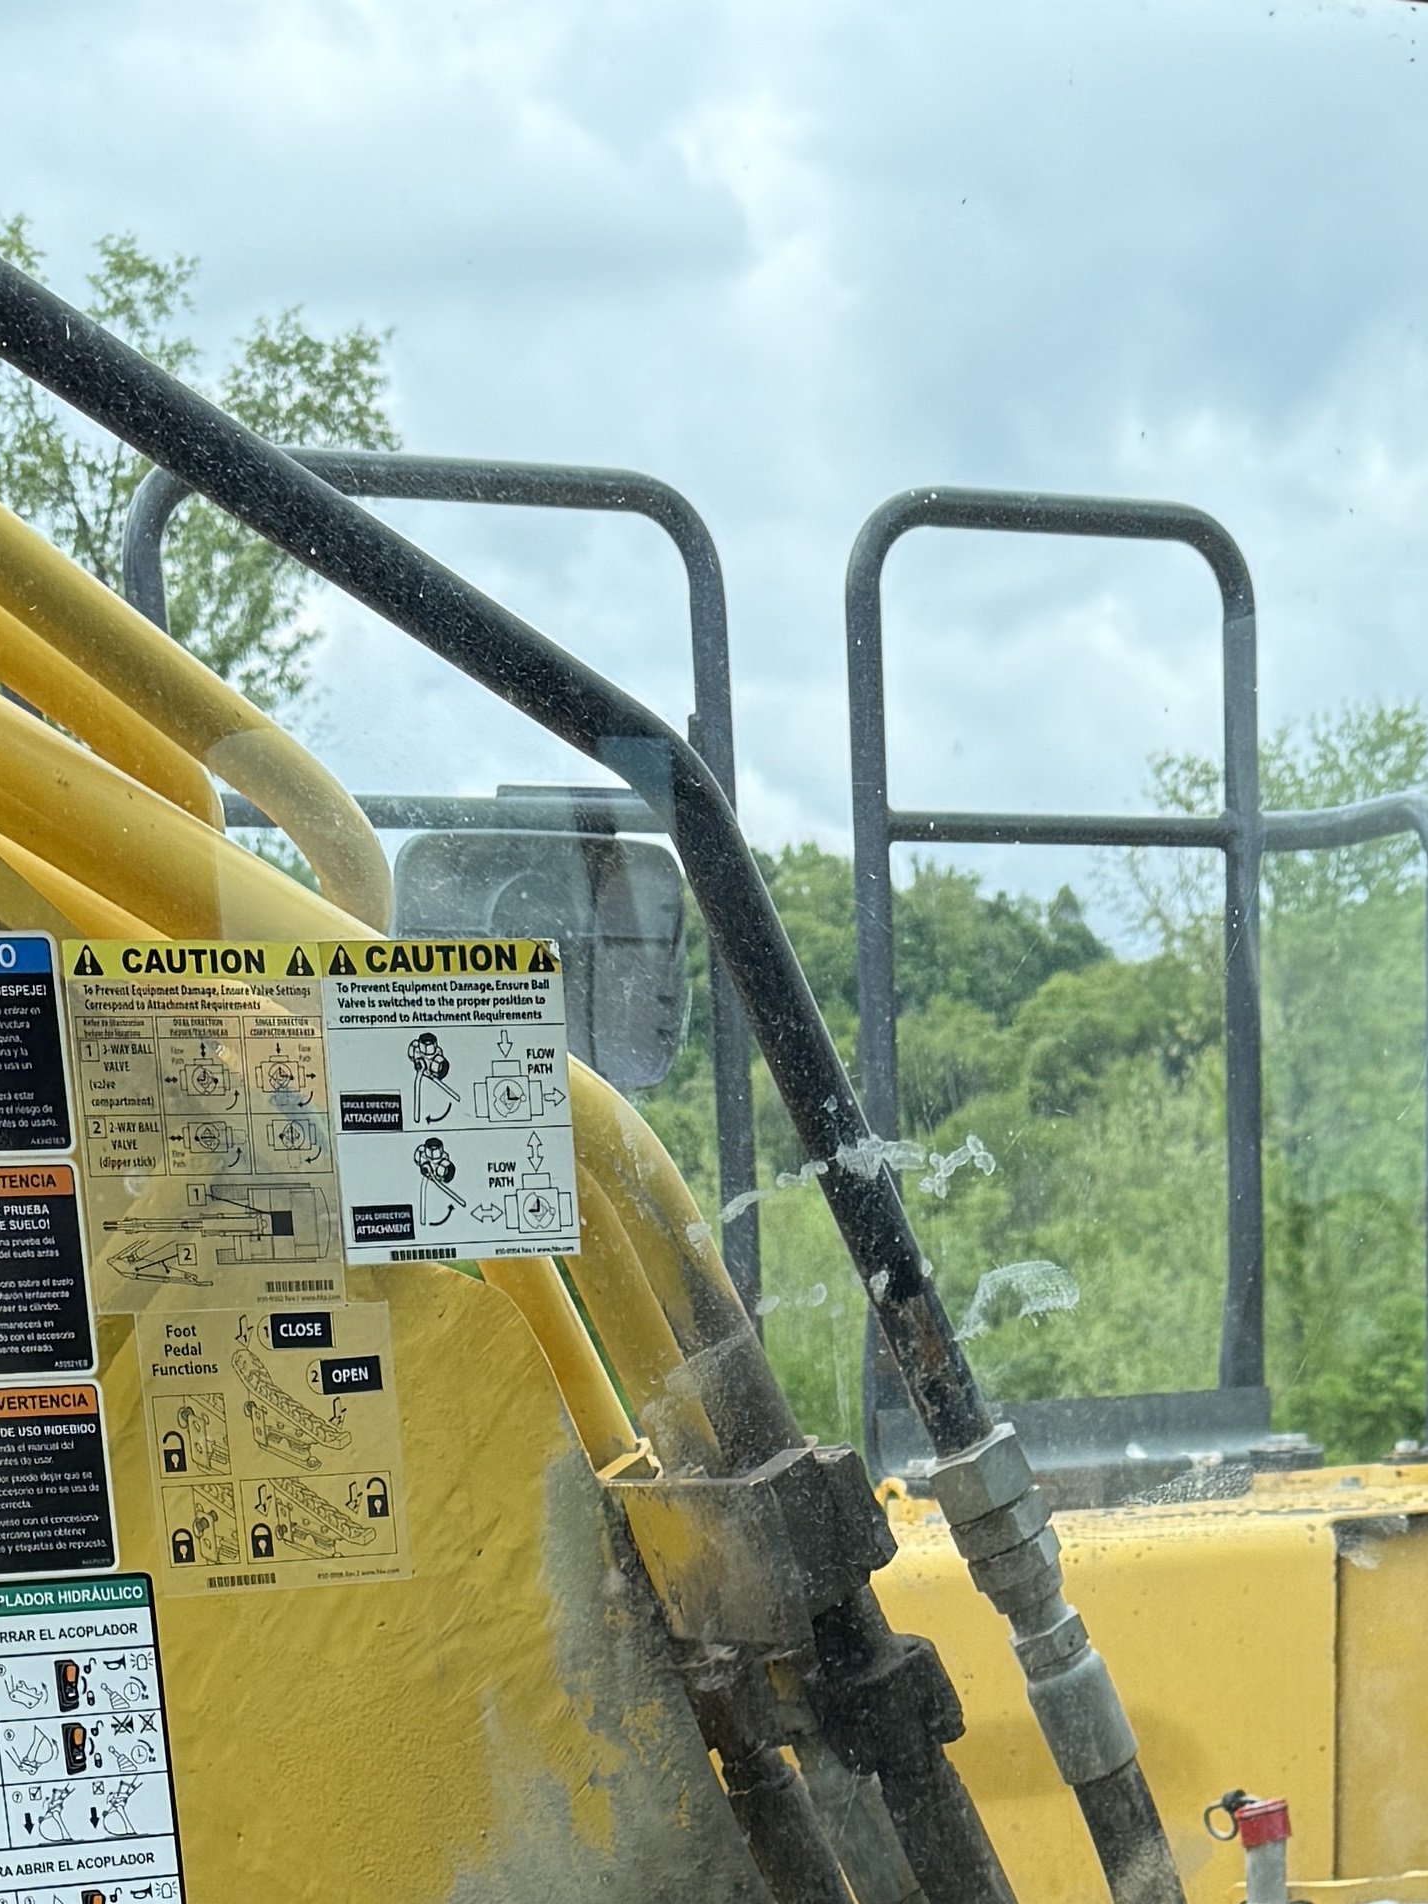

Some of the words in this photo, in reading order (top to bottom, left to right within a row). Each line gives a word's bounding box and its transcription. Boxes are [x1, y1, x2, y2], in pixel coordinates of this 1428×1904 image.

[122, 948, 265, 974] CAUTION
[365, 944, 517, 972] CAUTION
[83, 985, 93, 995] To
[96, 985, 129, 996] Prevent
[132, 985, 179, 997] Equipment
[181, 985, 219, 998] Damage,
[221, 986, 249, 995] Ensure
[251, 986, 274, 995] Valve
[276, 985, 311, 997] Settings
[336, 983, 348, 993] To
[350, 982, 389, 993] Prevent
[392, 982, 448, 995] Equipment
[450, 980, 493, 994] Damage,
[495, 980, 528, 989] Ensure
[531, 979, 549, 989] Ball
[85, 1001, 134, 1013] Correspond
[137, 1001, 146, 1010] to
[147, 1000, 198, 1010] Attachment
[201, 1000, 261, 1011] Requirements
[338, 998, 365, 1008] Valve
[367, 998, 375, 1008] is
[378, 997, 422, 1008] switched
[425, 996, 435, 1005] to
[438, 996, 454, 1006] the
[457, 997, 490, 1008] proper
[493, 995, 533, 1006] position
[535, 995, 545, 1004] to
[339, 1013, 397, 1025] correspond
[399, 1012, 409, 1022] to
[412, 1011, 471, 1022] Attachment
[473, 1010, 542, 1022] Requirements
[87, 1045, 92, 1057] 1
[103, 1044, 129, 1055] 3-WAY
[131, 1044, 153, 1054] BALL
[526, 1048, 554, 1060] FLOW
[104, 1062, 130, 1072] VALVE
[527, 1064, 552, 1074] PATH
[90, 1080, 115, 1091] (valve
[91, 1097, 154, 1108] compartment)
[344, 1113, 399, 1123] ATTACHMENT
[93, 1122, 101, 1133] 2
[110, 1122, 136, 1133] 2-WAY
[139, 1122, 159, 1132] BALL
[112, 1140, 138, 1150] VALVE
[100, 1157, 131, 1169] (dipper
[134, 1155, 156, 1168] stick)
[488, 1162, 516, 1173] FLOW
[489, 1177, 514, 1188] PATH
[4, 1204, 49, 1216] PRUEBA
[10, 1219, 50, 1230] SUELO!
[356, 1223, 412, 1234] ATTACHMENT
[166, 1326, 196, 1337] Foot
[265, 1327, 269, 1338] 1
[280, 1323, 321, 1336] CLOSE
[164, 1343, 201, 1356] Pedal
[152, 1362, 218, 1376] Functions
[311, 1371, 319, 1382] 2
[333, 1368, 368, 1382] OPEN
[0, 1427, 15, 1437] DE
[18, 1426, 41, 1436] USO
[44, 1423, 96, 1435] INDEBIDO
[58, 1586, 142, 1604] HIDRÁULICO
[40, 1629, 55, 1639] EL
[59, 1623, 138, 1638] ACOPLADOR
[16, 1863, 55, 1876] ABRIR
[59, 1860, 74, 1871] EL
[76, 1853, 155, 1870] ACOPLADOR
